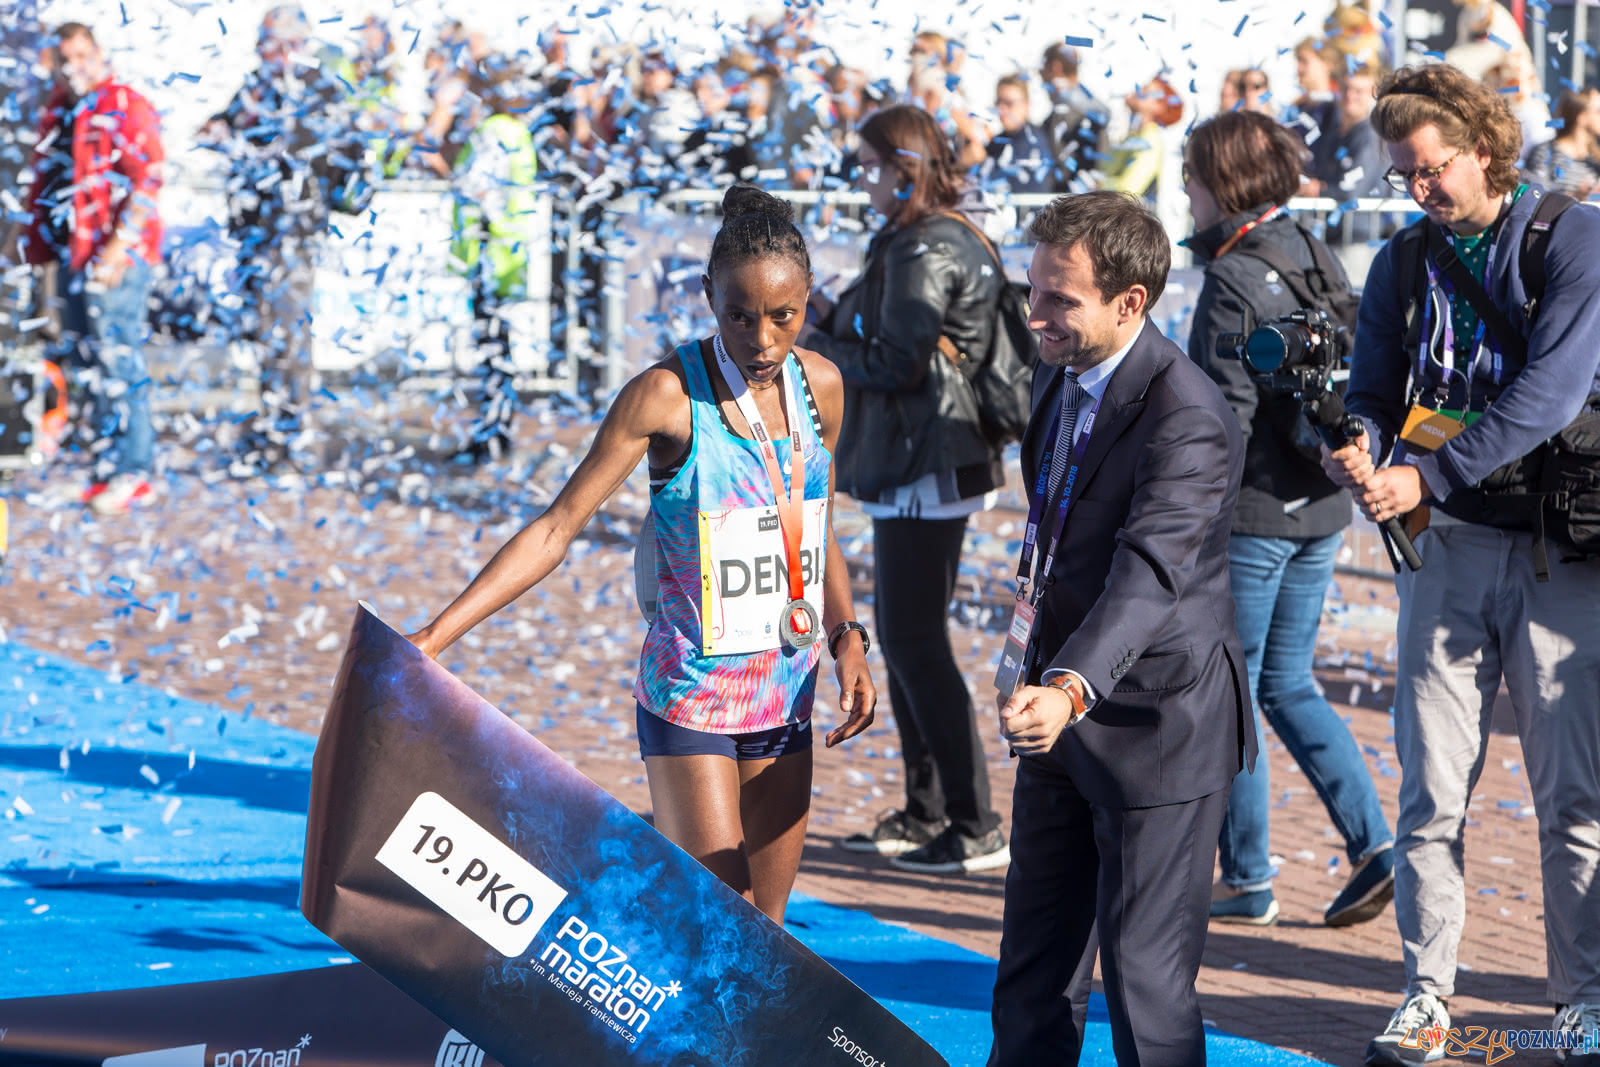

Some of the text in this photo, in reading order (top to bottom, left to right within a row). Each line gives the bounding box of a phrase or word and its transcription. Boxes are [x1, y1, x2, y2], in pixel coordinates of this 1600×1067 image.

[1419, 423, 1446, 439] MEDIA
[1036, 451, 1052, 495] 14.10.2018
[1060, 465, 1078, 508] 14.10.2018
[719, 547, 824, 598] DENBI
[455, 858, 534, 926] PKO
[540, 941, 651, 1034] maraton
[548, 972, 582, 1004] Macieja
[582, 999, 637, 1044] Frankiewicza
[827, 1026, 879, 1067] Sponsor
